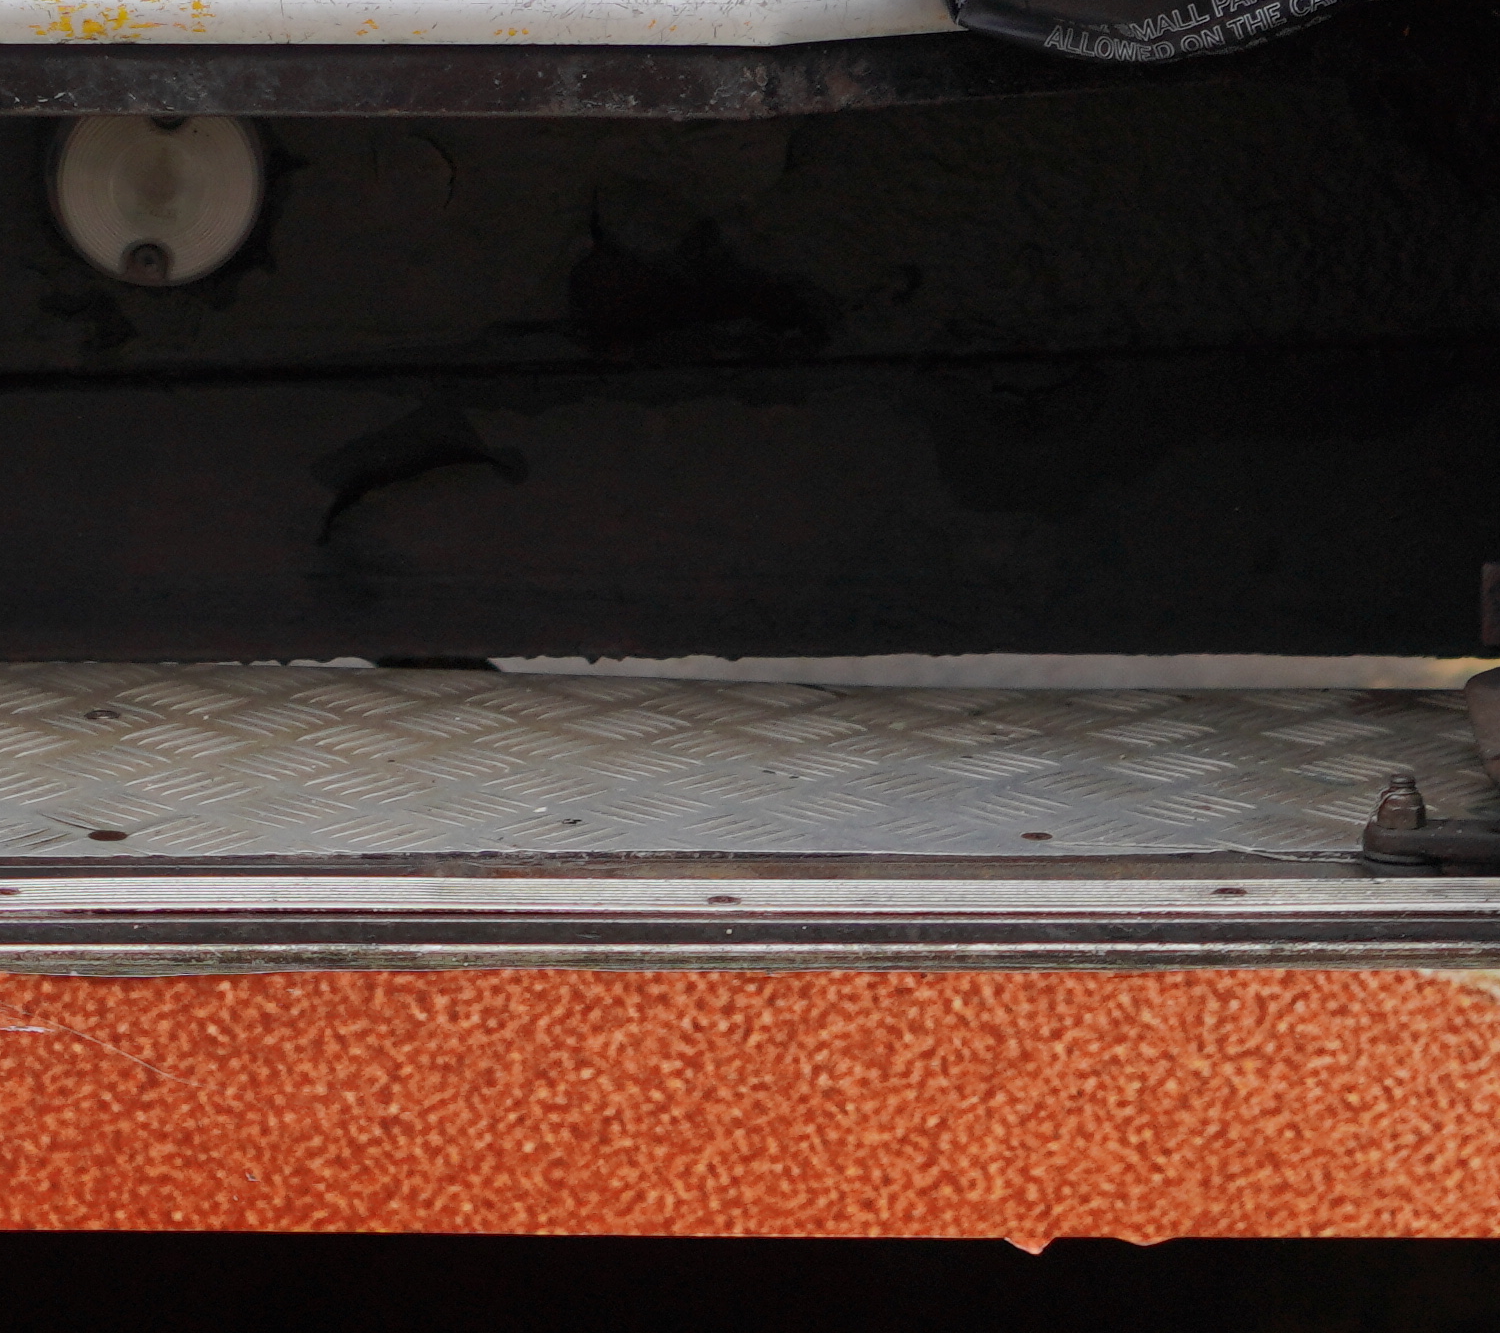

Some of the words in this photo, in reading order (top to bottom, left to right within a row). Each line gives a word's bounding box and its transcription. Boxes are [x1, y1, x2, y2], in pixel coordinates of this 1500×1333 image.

[1043, 25, 1175, 62] ALLOWED
[1181, 25, 1225, 53] ON
[1227, 2, 1287, 40] THE
